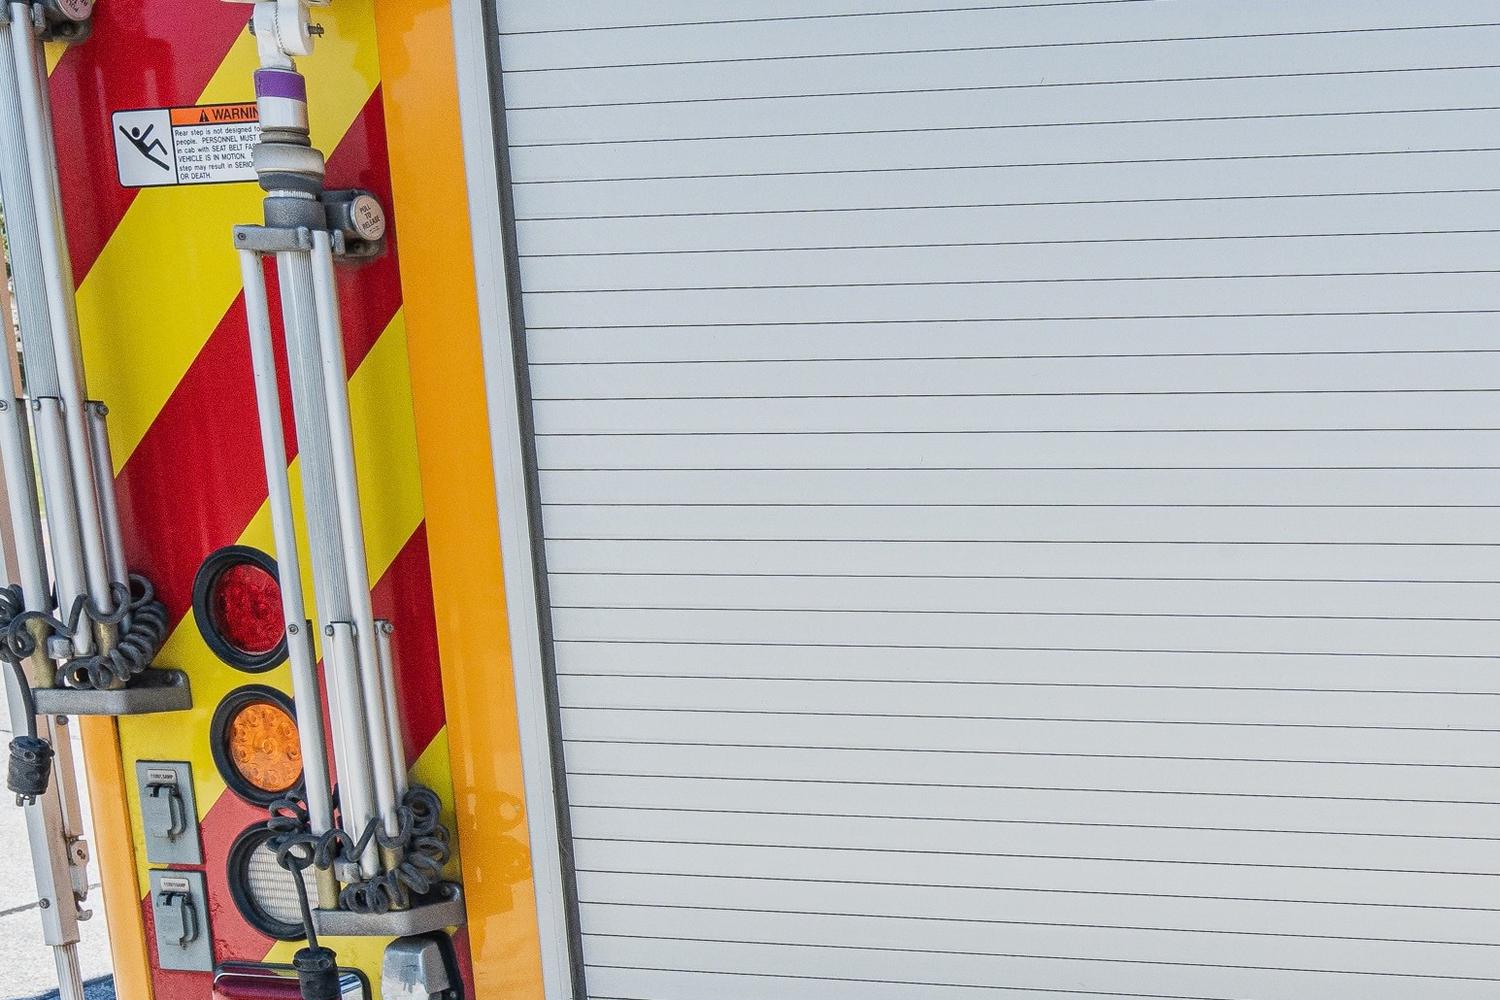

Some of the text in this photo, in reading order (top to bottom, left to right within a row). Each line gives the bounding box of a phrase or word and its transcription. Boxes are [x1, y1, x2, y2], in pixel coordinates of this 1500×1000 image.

[212, 107, 259, 120] WARNIN
[191, 128, 203, 136] step
[225, 126, 252, 135] designed
[202, 136, 238, 144] PERSONNEL
[211, 144, 226, 152] SEAT
[178, 154, 203, 162] VEHICLE
[221, 152, 245, 160] MOTION.
[209, 162, 225, 170] result
[234, 160, 255, 169] SERIO
[180, 172, 189, 180] OR
[360, 204, 371, 214] PULL
[362, 215, 380, 229] RELEASE
